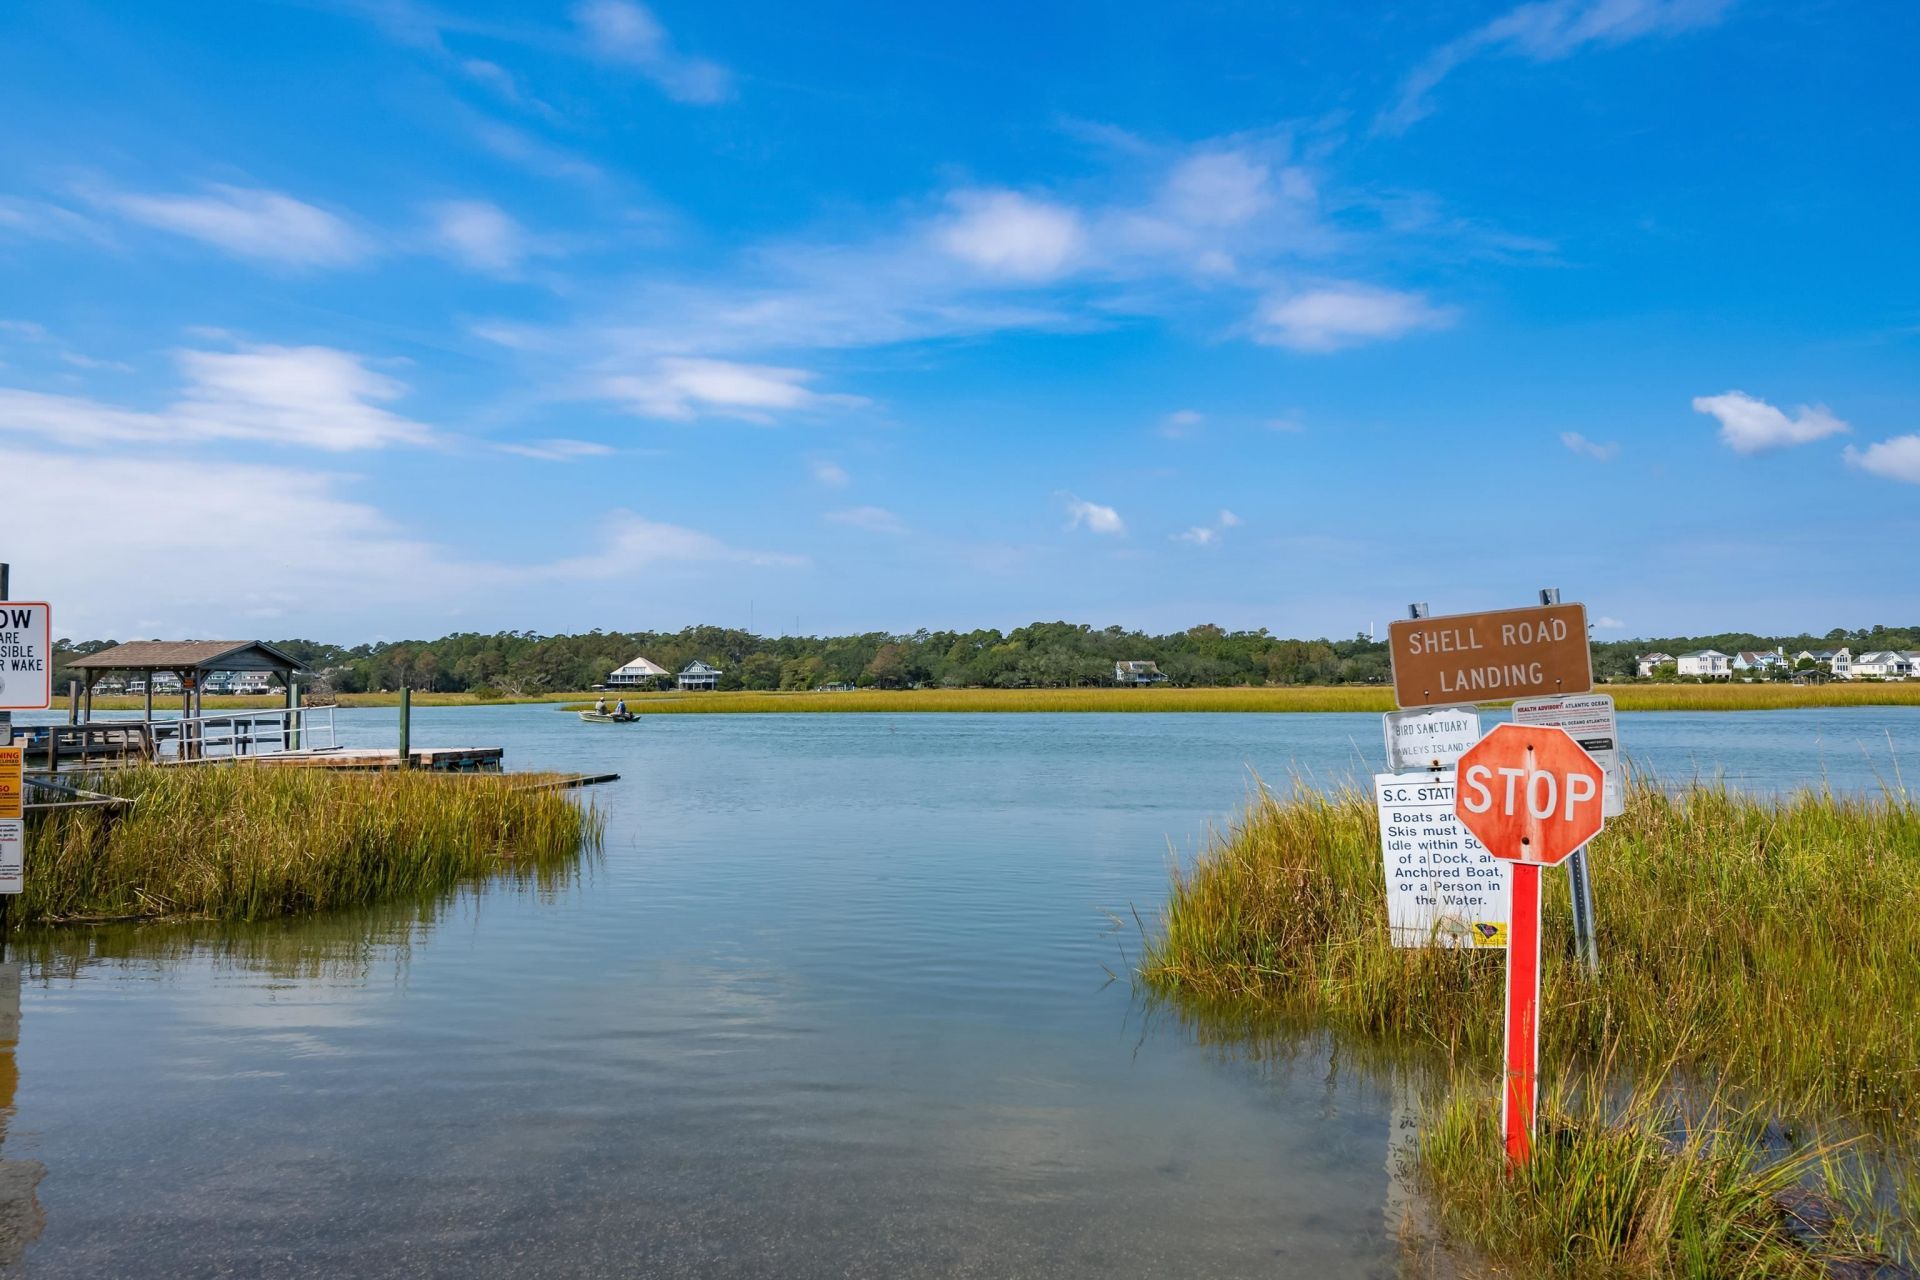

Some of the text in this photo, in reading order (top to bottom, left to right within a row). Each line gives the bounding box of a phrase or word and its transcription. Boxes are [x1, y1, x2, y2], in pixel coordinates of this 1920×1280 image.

[1409, 619, 1567, 655] SHELL ROAD
[0, 645, 34, 658] SIBLE
[11, 659, 43, 671] WAKE
[1439, 662, 1544, 692] LANDING
[1395, 719, 1468, 737] BIRD SANCTUARY
[1432, 742, 1464, 754] ISLAND
[1383, 789, 1411, 802] S.C.
[1463, 764, 1597, 822] STOP
[1393, 812, 1433, 823] Boats
[1388, 826, 1417, 837] Skis
[1423, 825, 1457, 836] must
[1388, 840, 1412, 851] Idle
[1418, 839, 1458, 850] within
[1399, 853, 1412, 864] of
[1419, 855, 1427, 864] a
[1432, 853, 1473, 865] Dock,
[1395, 866, 1504, 878] Anchored Boat,
[1400, 880, 1500, 892] or a Person in
[1415, 894, 1487, 906] the Water.
